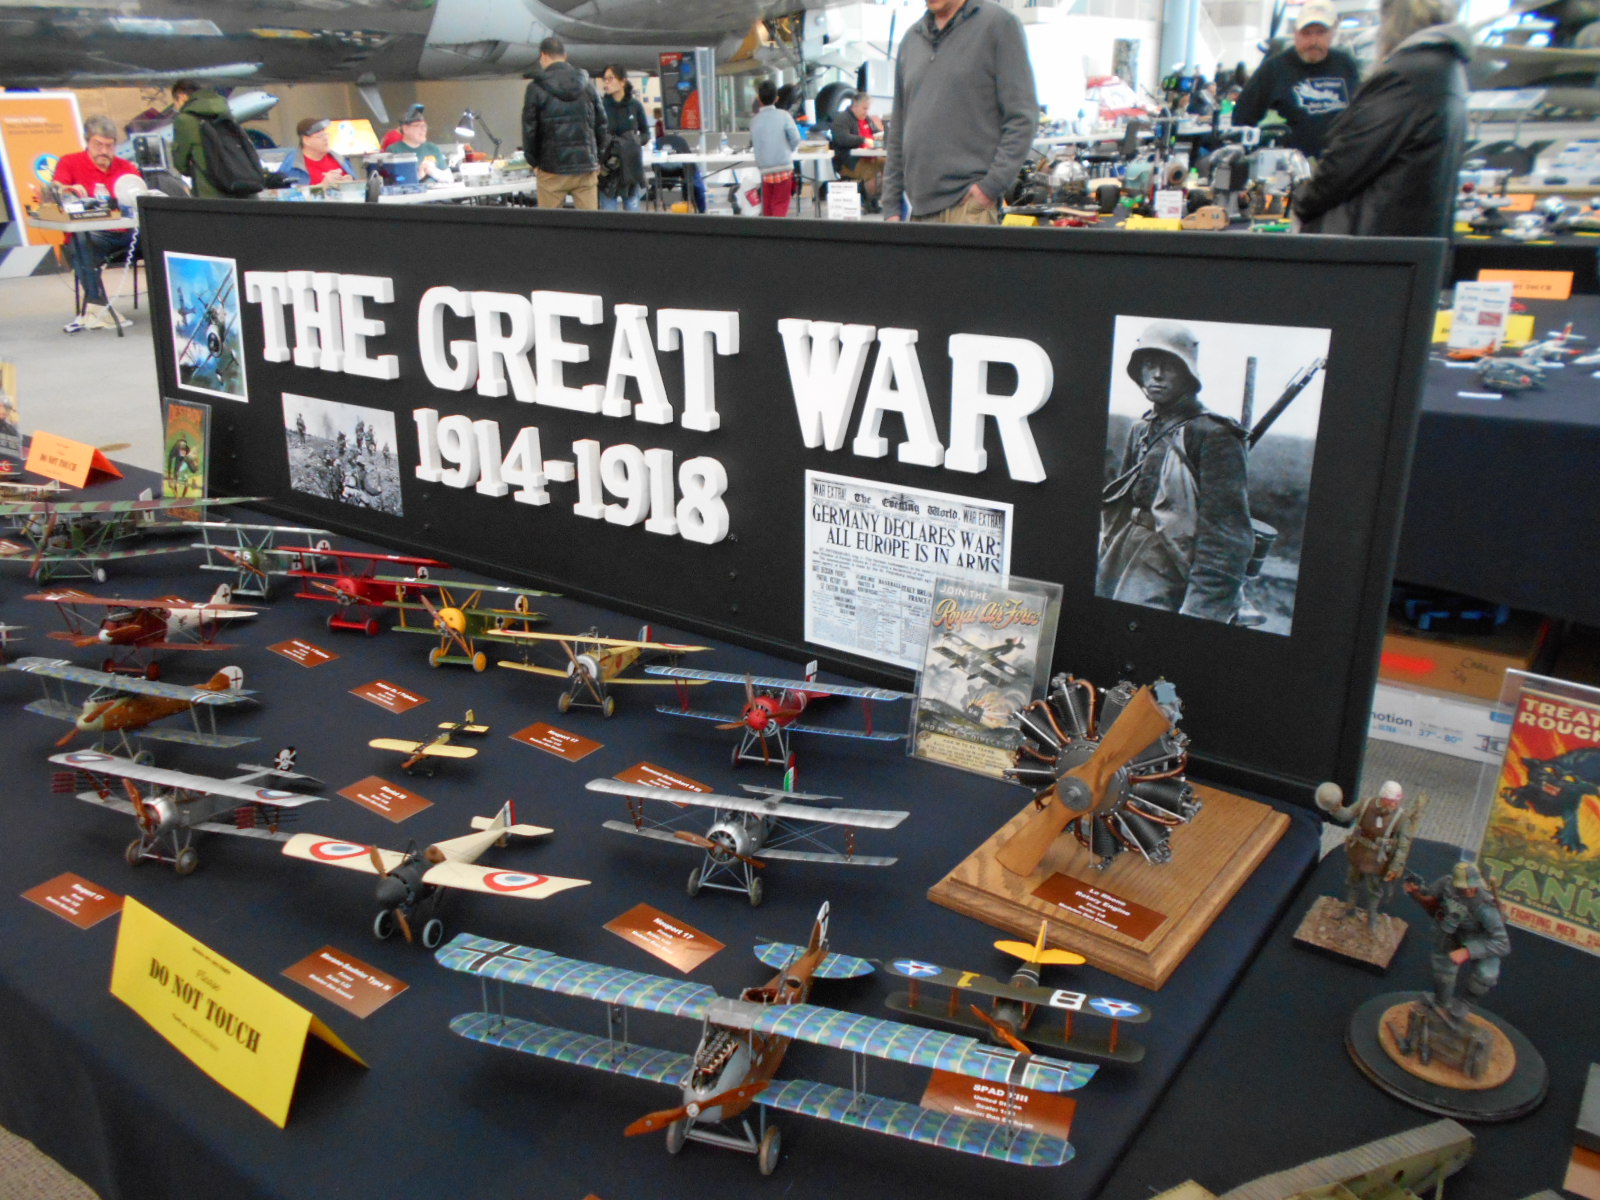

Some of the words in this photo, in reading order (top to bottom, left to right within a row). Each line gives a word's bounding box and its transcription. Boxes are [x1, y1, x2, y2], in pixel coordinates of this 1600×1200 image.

[245, 269, 400, 381] THE
[418, 285, 741, 432] GREAT
[777, 318, 1054, 483] WAR
[413, 407, 730, 545] 1914-1918
[813, 483, 826, 498] WAR
[854, 492, 872, 504] The
[881, 496, 920, 516] Evening
[963, 509, 978, 524] WAR
[812, 502, 880, 533] GERMANY
[883, 516, 956, 548] DECLARES
[961, 530, 1001, 558] WAR;
[826, 526, 851, 548] ALL
[856, 531, 910, 560] EUROPE
[915, 542, 929, 563] IS
[934, 546, 949, 565] IN
[957, 551, 1001, 574] ARMS
[940, 584, 966, 598] JOIN
[969, 590, 989, 601] THE
[932, 598, 980, 632] Royal
[979, 601, 1005, 624] Air
[991, 598, 1042, 631] Force
[1522, 697, 1600, 728] TREAT
[1510, 856, 1565, 880] JOIN
[1075, 890, 1102, 905] Rotary
[1102, 902, 1131, 916] Engine
[1088, 888, 1100, 896] Le
[1100, 892, 1127, 907] Rhone
[682, 931, 695, 940] 17
[367, 976, 385, 989] Type
[149, 957, 170, 987] DO
[171, 973, 204, 1012] NOT
[205, 997, 262, 1055] TOUCH
[973, 1084, 1006, 1098] SPAD
[973, 1094, 998, 1106] United
